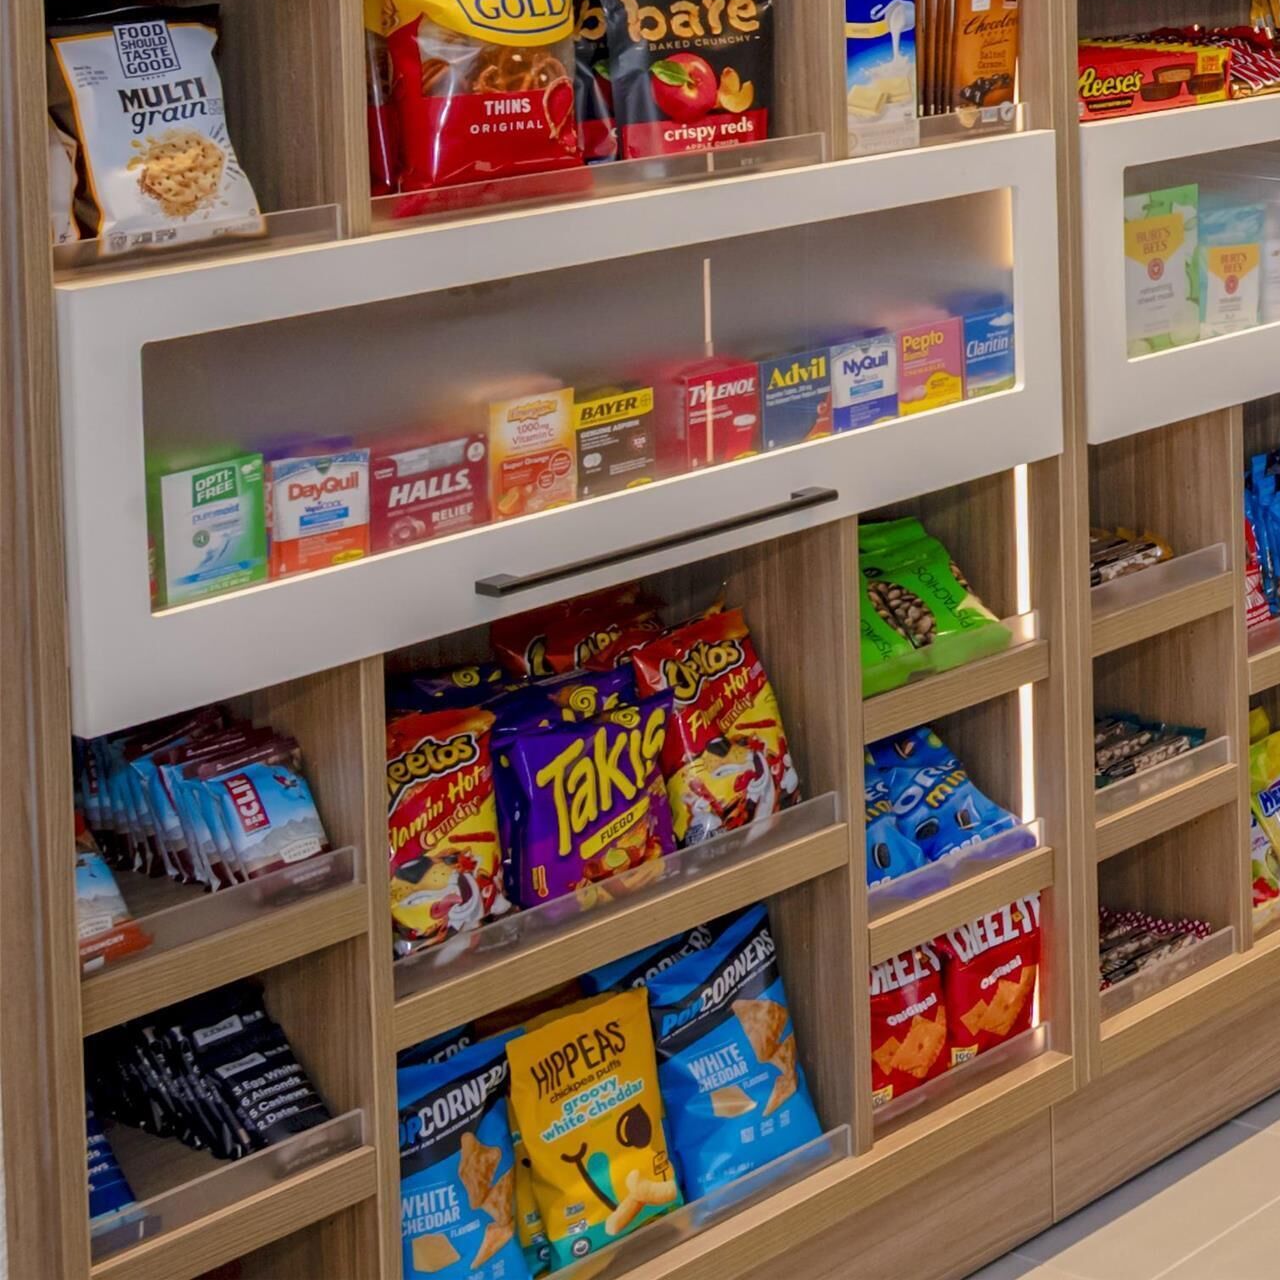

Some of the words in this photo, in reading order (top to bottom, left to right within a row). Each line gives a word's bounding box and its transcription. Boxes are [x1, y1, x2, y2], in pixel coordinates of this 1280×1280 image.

[118, 23, 165, 40] FOOD
[120, 36, 168, 51] SHOULD
[649, 40, 690, 51] BAKED
[694, 35, 751, 47] CRUNCHY
[123, 46, 170, 62] TASTE
[126, 57, 175, 75] GOOD
[117, 77, 207, 112] MULTI
[1079, 68, 1144, 97] Reese's
[131, 100, 208, 134] grain
[484, 98, 531, 115] THINS
[470, 120, 543, 134] ORIGINAL
[664, 126, 716, 142] crispy
[720, 117, 754, 134] reds
[1136, 226, 1171, 241] BURT'S
[1143, 240, 1168, 255] BEES
[902, 330, 944, 353] Pepto
[966, 337, 1009, 358] Claritin
[767, 356, 826, 390] Advil
[843, 350, 889, 376] NyQuil
[688, 377, 756, 407] TYLENOL
[580, 396, 638, 421] BAYER
[512, 433, 545, 446] Vitamin
[547, 429, 554, 437] C
[503, 460, 523, 470] Super
[524, 455, 550, 466] Orange
[195, 469, 233, 490] OPTI-
[197, 480, 234, 503] FREE
[288, 472, 359, 501] DayQuil
[432, 502, 474, 523] RELIEF
[724, 667, 751, 697] Hot
[448, 765, 486, 805] Hot
[420, 795, 481, 850] Crunchy
[600, 812, 635, 843] FUEGO
[980, 955, 1022, 990] Original
[887, 993, 937, 1026] Original
[529, 1020, 627, 1100] HIPPEAS
[688, 1042, 745, 1080] WHITE
[233, 1085, 242, 1096] 3
[242, 1076, 267, 1091] Egg
[550, 1073, 596, 1106] chickpea
[596, 1058, 622, 1083] puffs
[699, 1062, 749, 1093] CHEDDAR
[242, 1096, 251, 1107] 6
[252, 1076, 302, 1101] Almonds
[249, 1107, 258, 1119] 5
[259, 1087, 308, 1112] Cashews
[562, 1075, 618, 1116] groovy
[257, 1119, 267, 1131] 2
[268, 1105, 299, 1126] Dates
[541, 1111, 587, 1143] white
[589, 1077, 644, 1117] cheddar
